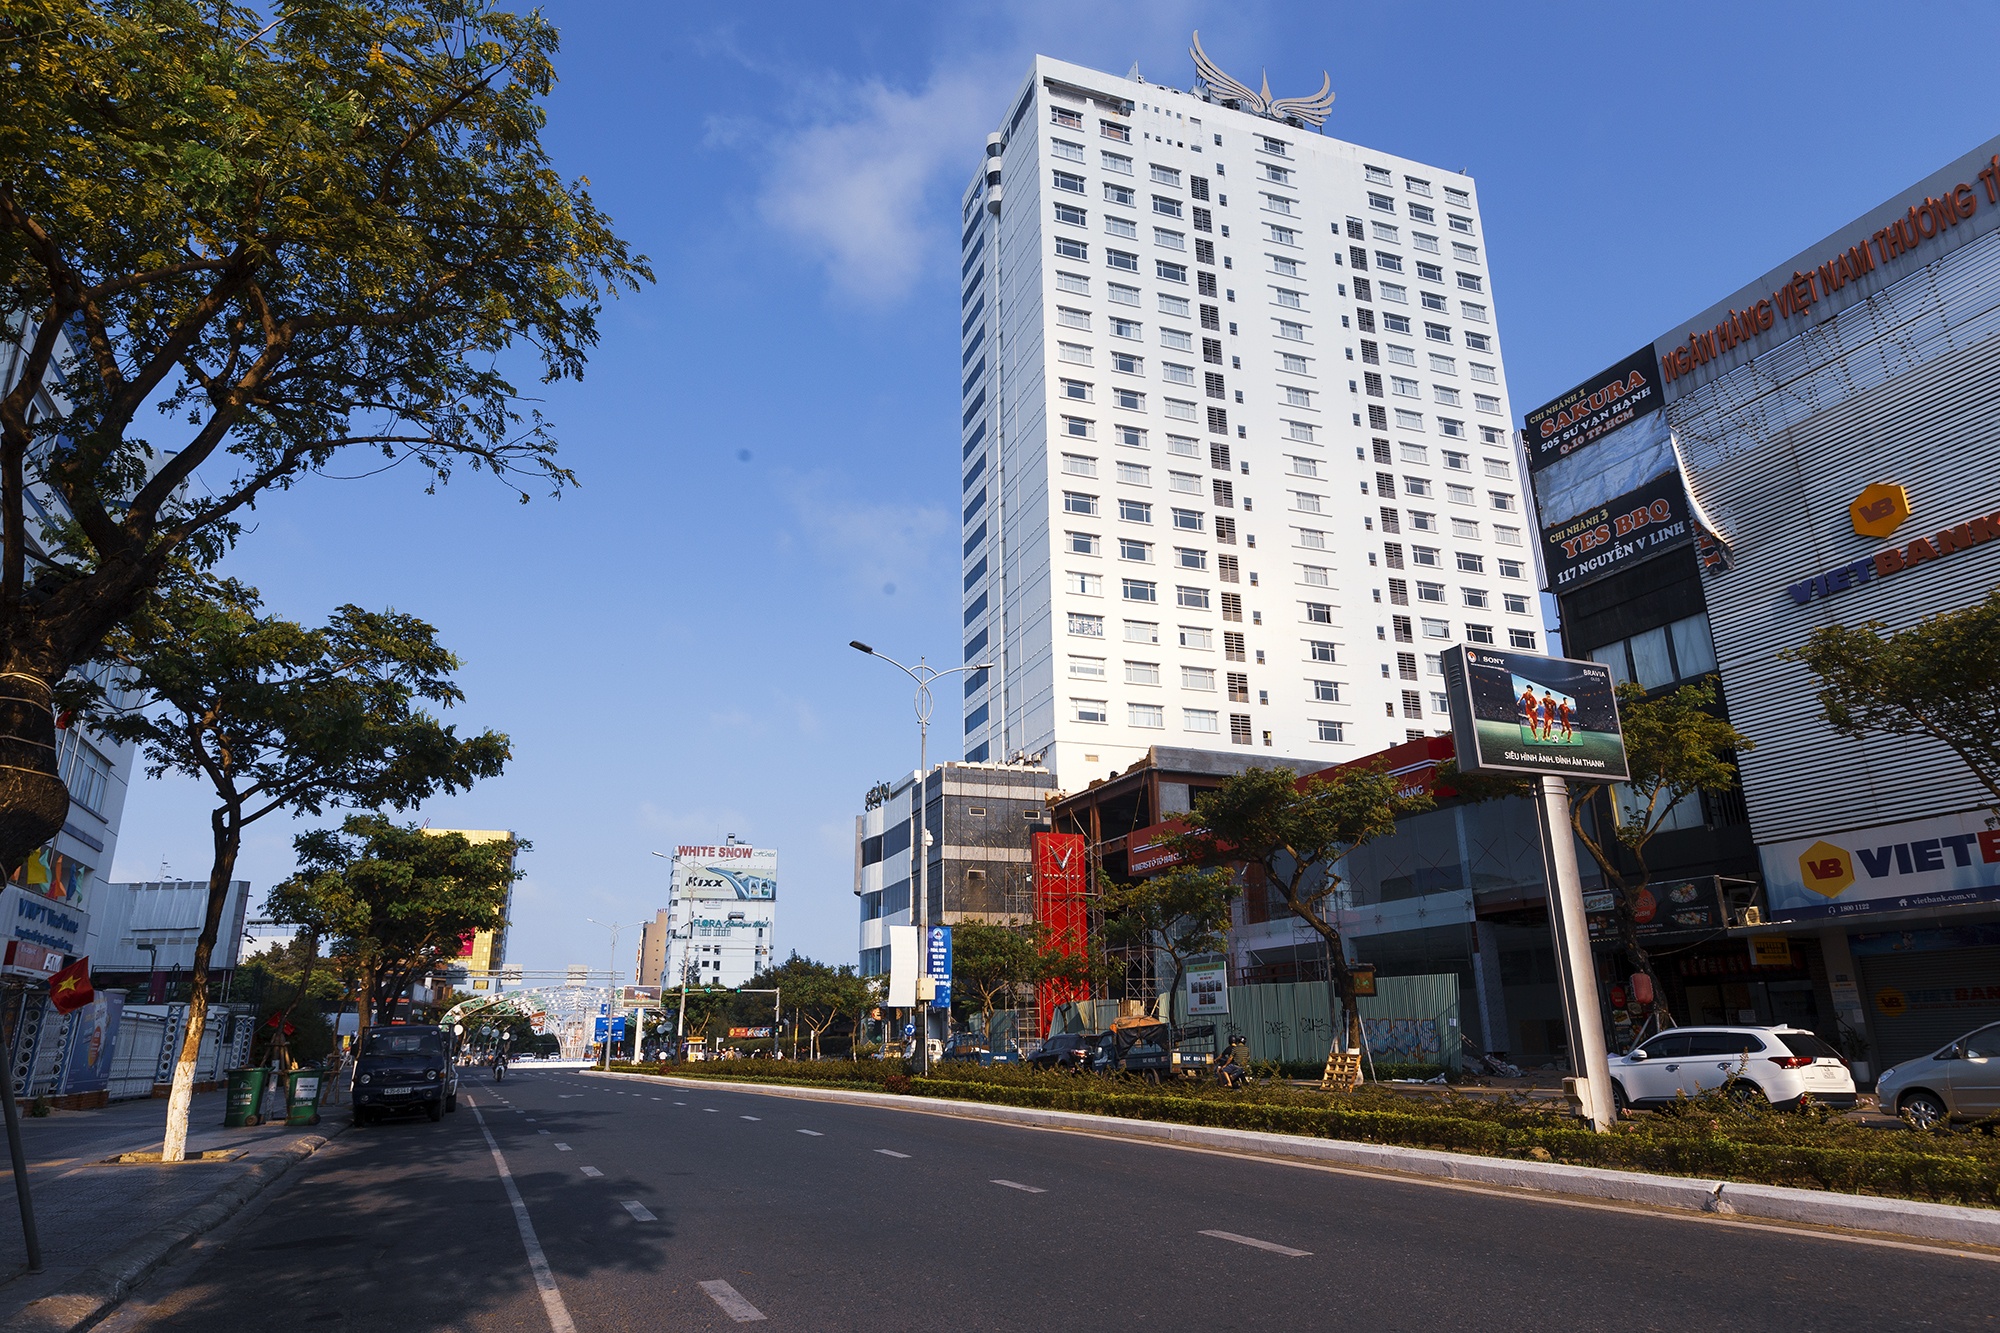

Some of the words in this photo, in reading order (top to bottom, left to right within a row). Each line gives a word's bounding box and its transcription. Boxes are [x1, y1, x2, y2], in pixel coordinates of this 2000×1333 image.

[1662, 332, 1716, 383] NGÂN
[1716, 299, 1774, 353] HÀNG
[1773, 271, 1818, 319] VIỆT
[1818, 239, 1875, 296] NAM
[1872, 184, 1977, 264] THƯƠNG
[1529, 412, 1545, 425] CHI
[1545, 395, 1578, 417] NHÁNH
[1540, 370, 1646, 438] SAKURA
[1541, 436, 1560, 453] 505
[1562, 424, 1580, 441] SƯ
[1581, 409, 1610, 428] VẠN
[1612, 386, 1652, 414] HẠNH
[1559, 436, 1585, 455] Q.10
[1586, 408, 1635, 440] TP.HCM
[1858, 496, 1896, 524] VB
[1549, 531, 1566, 544] CHI
[1566, 513, 1600, 537] NHÁNH
[1600, 508, 1609, 521] 3
[1561, 524, 1611, 559] YES
[1614, 498, 1672, 537] BBQ
[1557, 566, 1576, 585] 117
[1579, 541, 1635, 576] NGUYỄN
[1636, 536, 1647, 550] V
[1650, 520, 1686, 546] LINH
[1482, 655, 1505, 665] SONY
[1582, 668, 1606, 678] BRAVIA
[1520, 751, 1538, 762] HÌNH
[1582, 758, 1606, 768] THANH
[678, 845, 716, 858] WHITE
[718, 847, 753, 859] SNOW
[685, 876, 724, 888] Kixx
[1806, 857, 1844, 881] VB
[1840, 904, 1854, 913] 1800
[1854, 902, 1870, 911] 1122
[1912, 892, 1977, 906] vietbank.com.vn
[693, 918, 723, 929] FLORA
